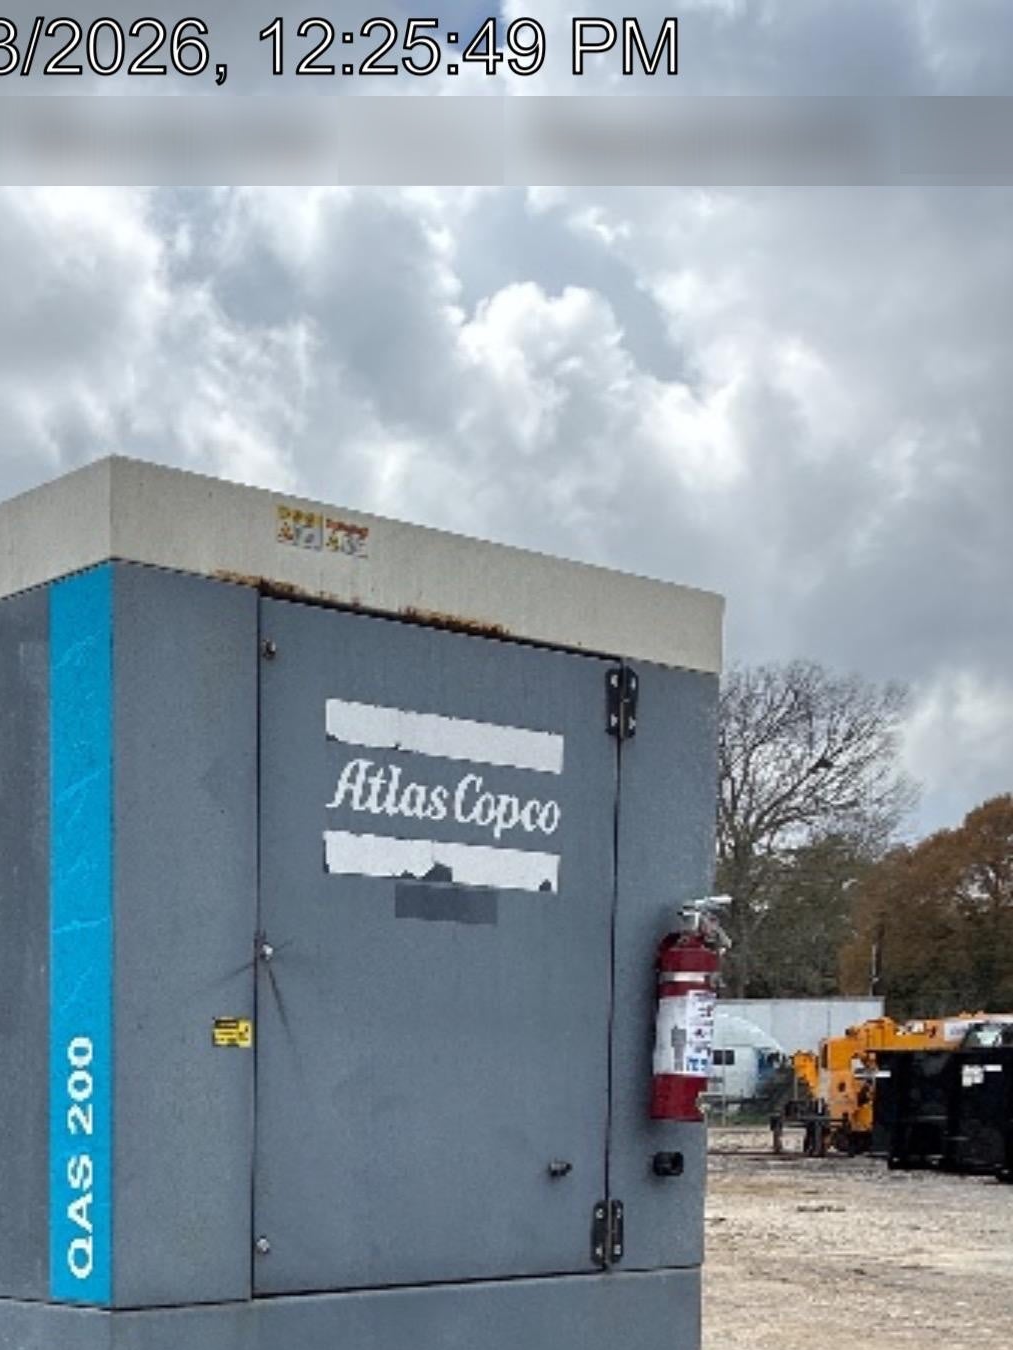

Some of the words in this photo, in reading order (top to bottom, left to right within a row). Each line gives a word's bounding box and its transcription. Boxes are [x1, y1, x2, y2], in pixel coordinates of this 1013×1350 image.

[325, 757, 450, 821] Atlas
[453, 772, 563, 839] Copco
[66, 1036, 94, 1135] 200
[66, 1154, 94, 1280] QAS
